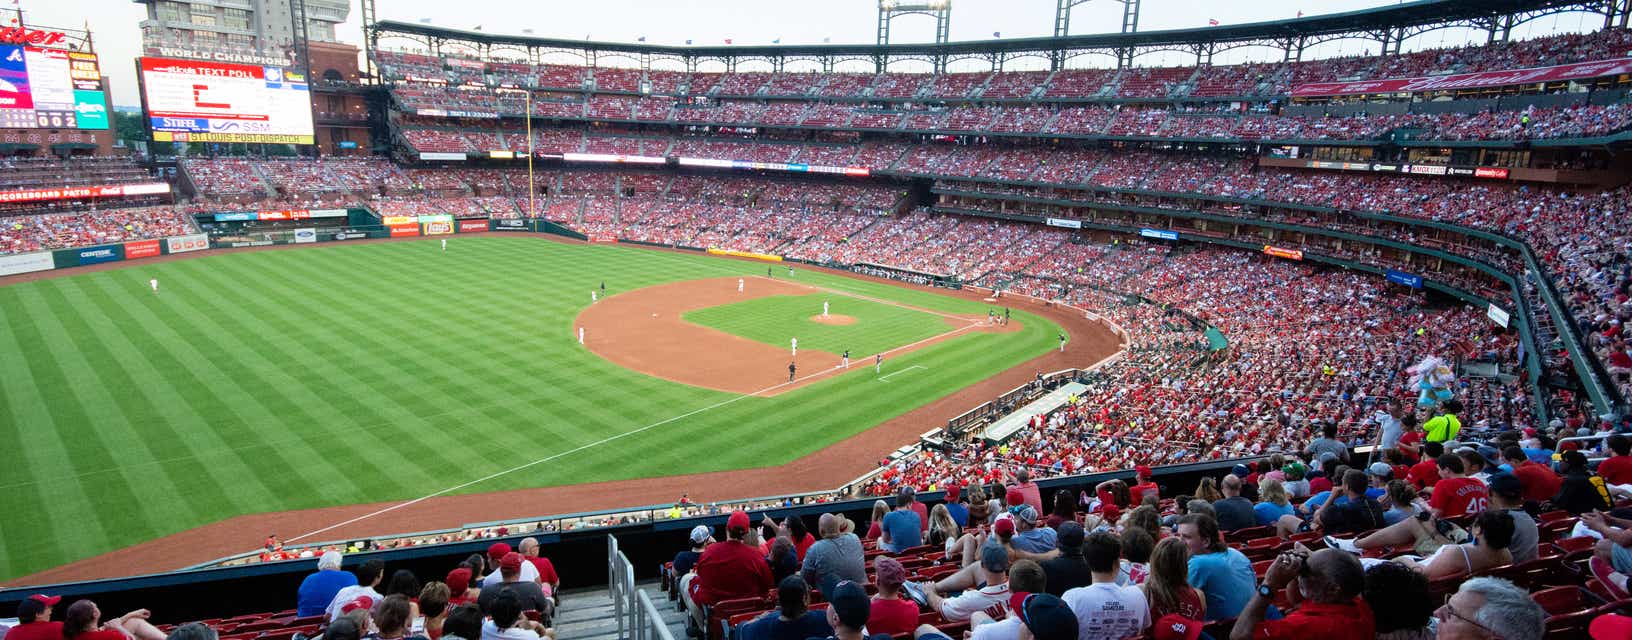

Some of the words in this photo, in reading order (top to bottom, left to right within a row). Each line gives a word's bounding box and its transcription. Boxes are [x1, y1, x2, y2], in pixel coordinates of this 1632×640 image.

[159, 47, 210, 59] WORLD
[214, 52, 291, 66] CHAMPIONS
[198, 67, 227, 77] TEXT
[228, 70, 256, 79] POLL
[38, 116, 49, 126] 0
[51, 116, 62, 126] 0
[65, 116, 76, 127] 2
[243, 122, 271, 132] SSM
[206, 133, 234, 142] LOUIS
[63, 188, 90, 197] PATIO
